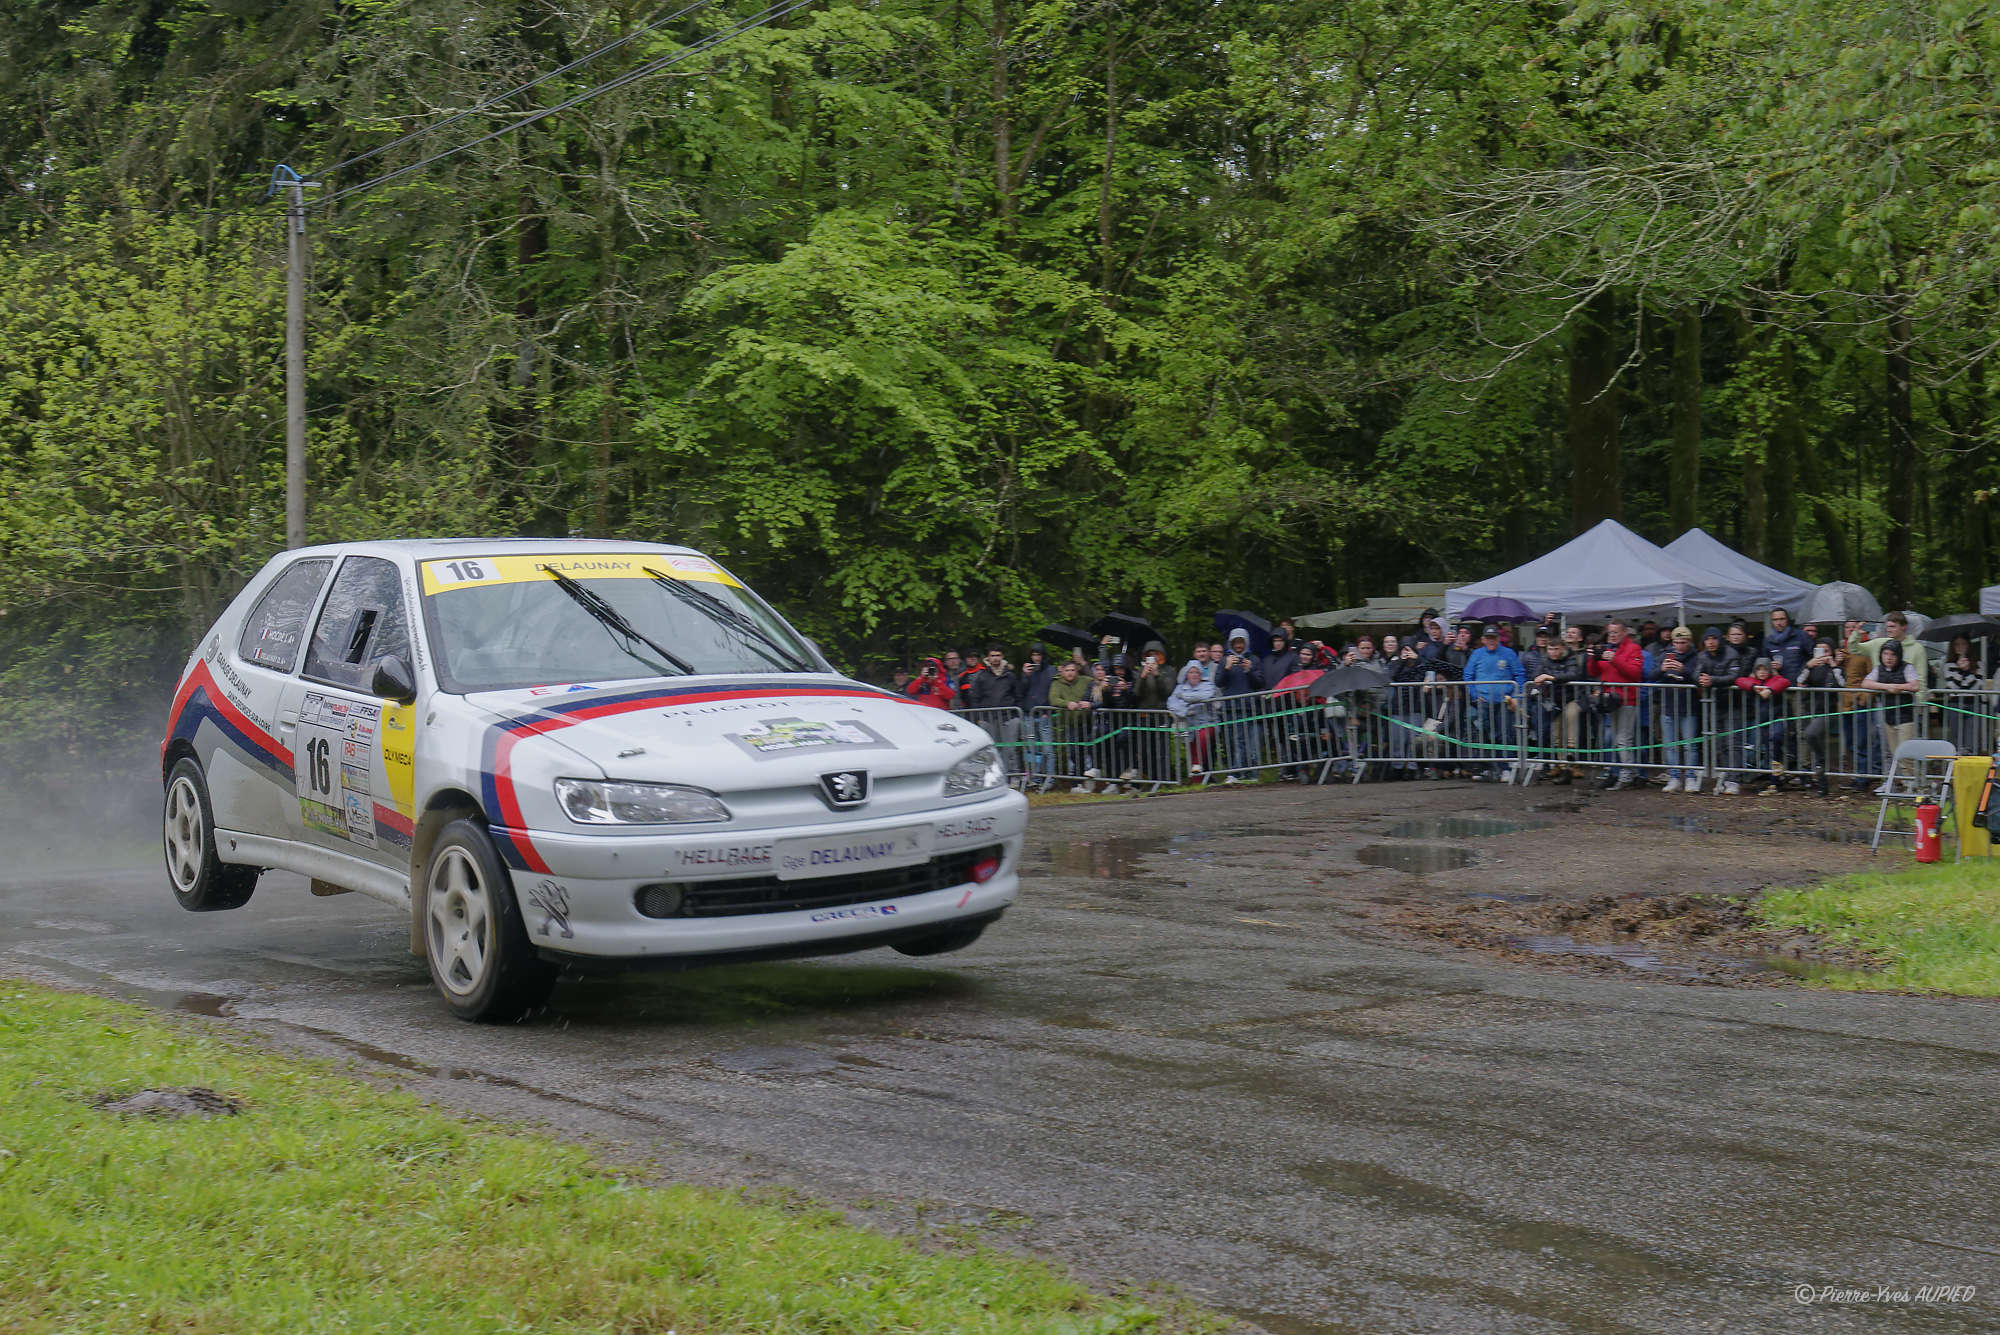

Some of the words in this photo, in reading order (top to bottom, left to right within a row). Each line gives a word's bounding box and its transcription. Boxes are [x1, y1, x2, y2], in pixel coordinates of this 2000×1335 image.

[445, 560, 485, 581] 16
[535, 561, 632, 573] DELAUNAY
[229, 671, 253, 699] DELAUNAY
[662, 701, 790, 718] PEUGEOT
[306, 737, 330, 795] 16
[810, 841, 895, 865] DELAUNAY
